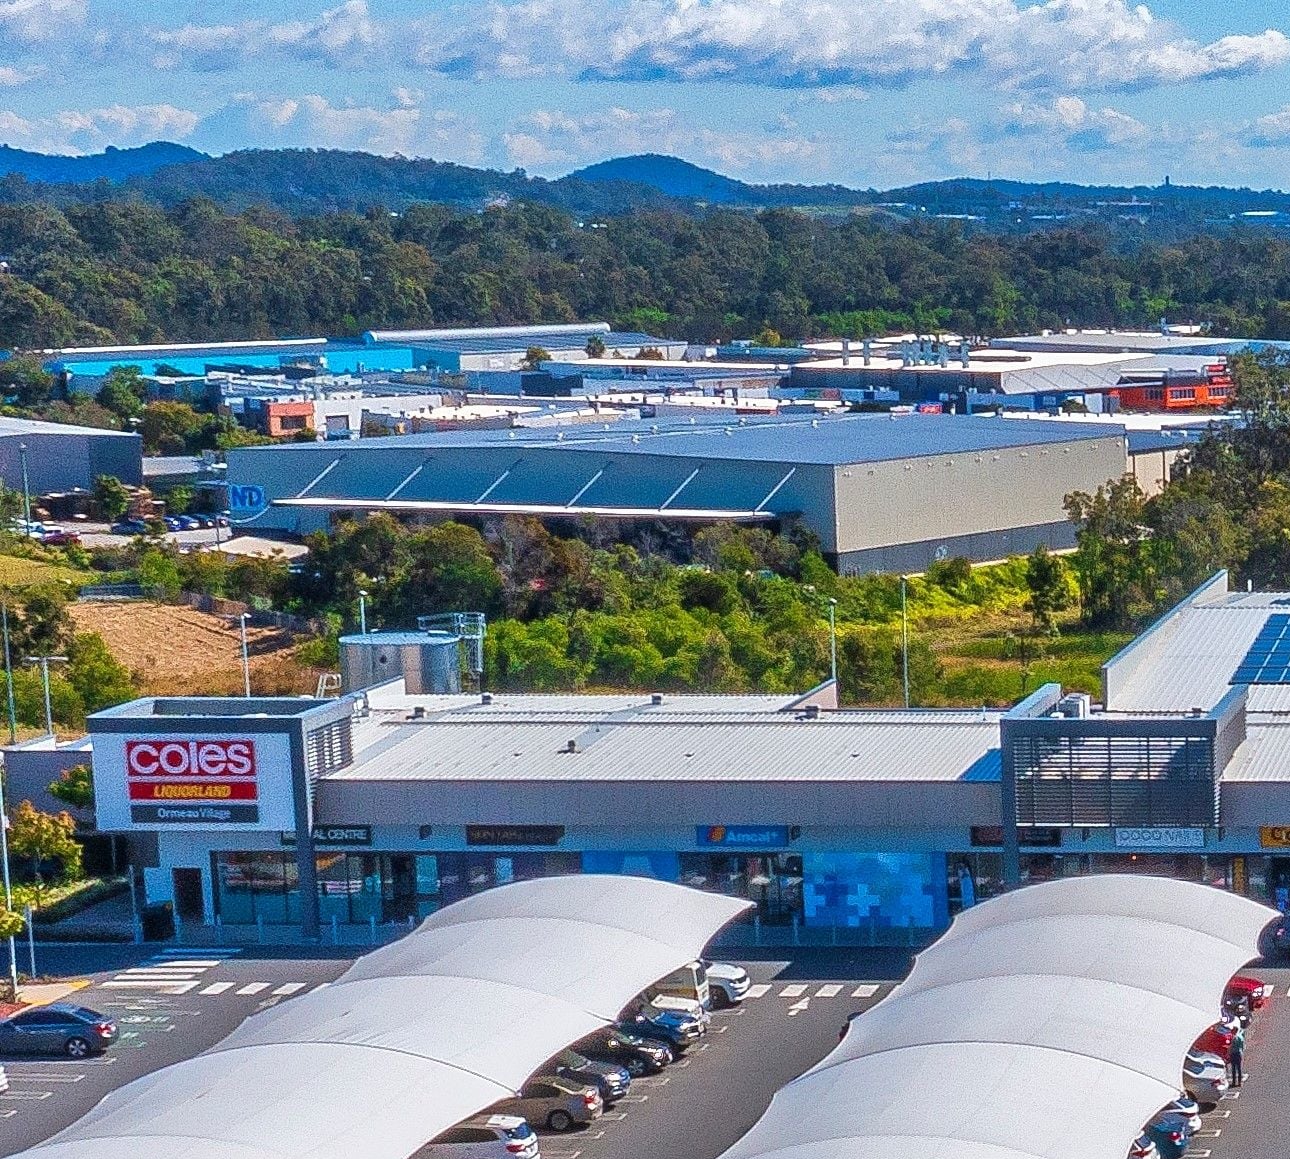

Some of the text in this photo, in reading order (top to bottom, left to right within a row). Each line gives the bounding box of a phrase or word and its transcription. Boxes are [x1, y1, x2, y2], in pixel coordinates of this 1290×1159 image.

[130, 741, 252, 774] coles
[153, 784, 232, 798] LIQUORLAND
[157, 807, 231, 820] Ormeau Village
[327, 829, 367, 840] CENTRE
